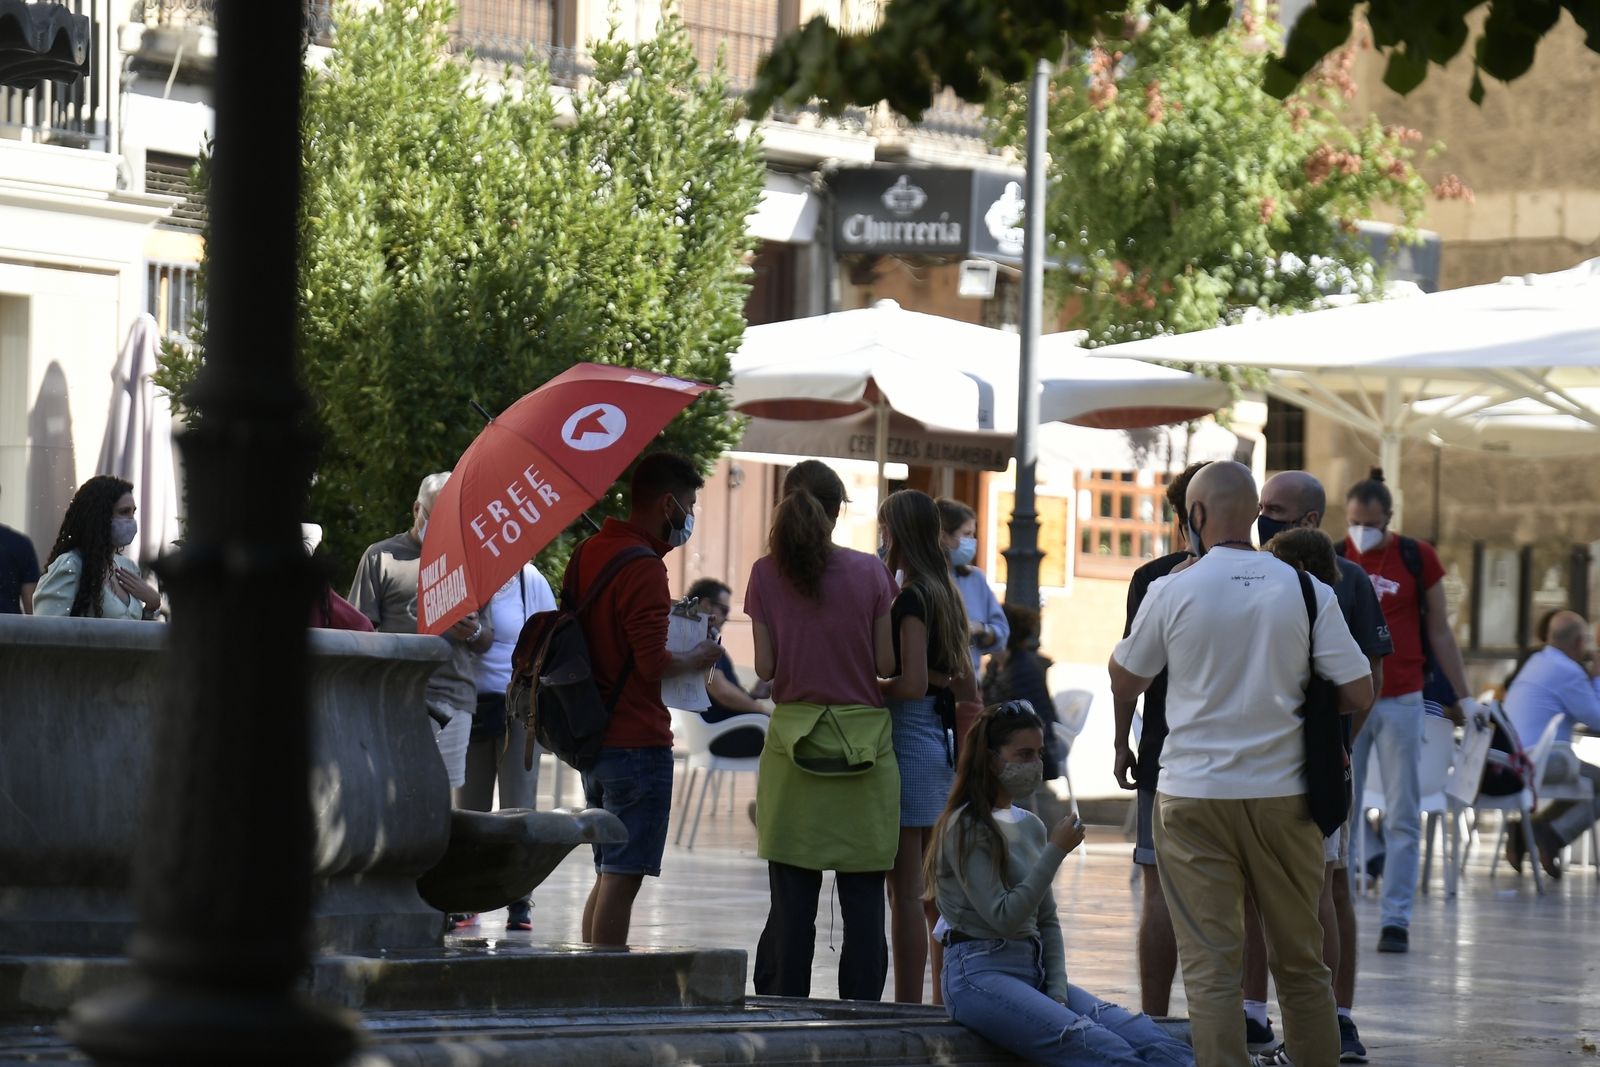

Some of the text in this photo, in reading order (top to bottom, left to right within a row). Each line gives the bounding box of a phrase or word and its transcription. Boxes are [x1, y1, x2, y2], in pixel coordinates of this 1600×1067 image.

[848, 434, 920, 458] CEREZAS
[470, 463, 545, 540] FREE
[481, 483, 561, 557] TOUR
[421, 558, 440, 591] WALK
[423, 564, 468, 628] GRANADA
